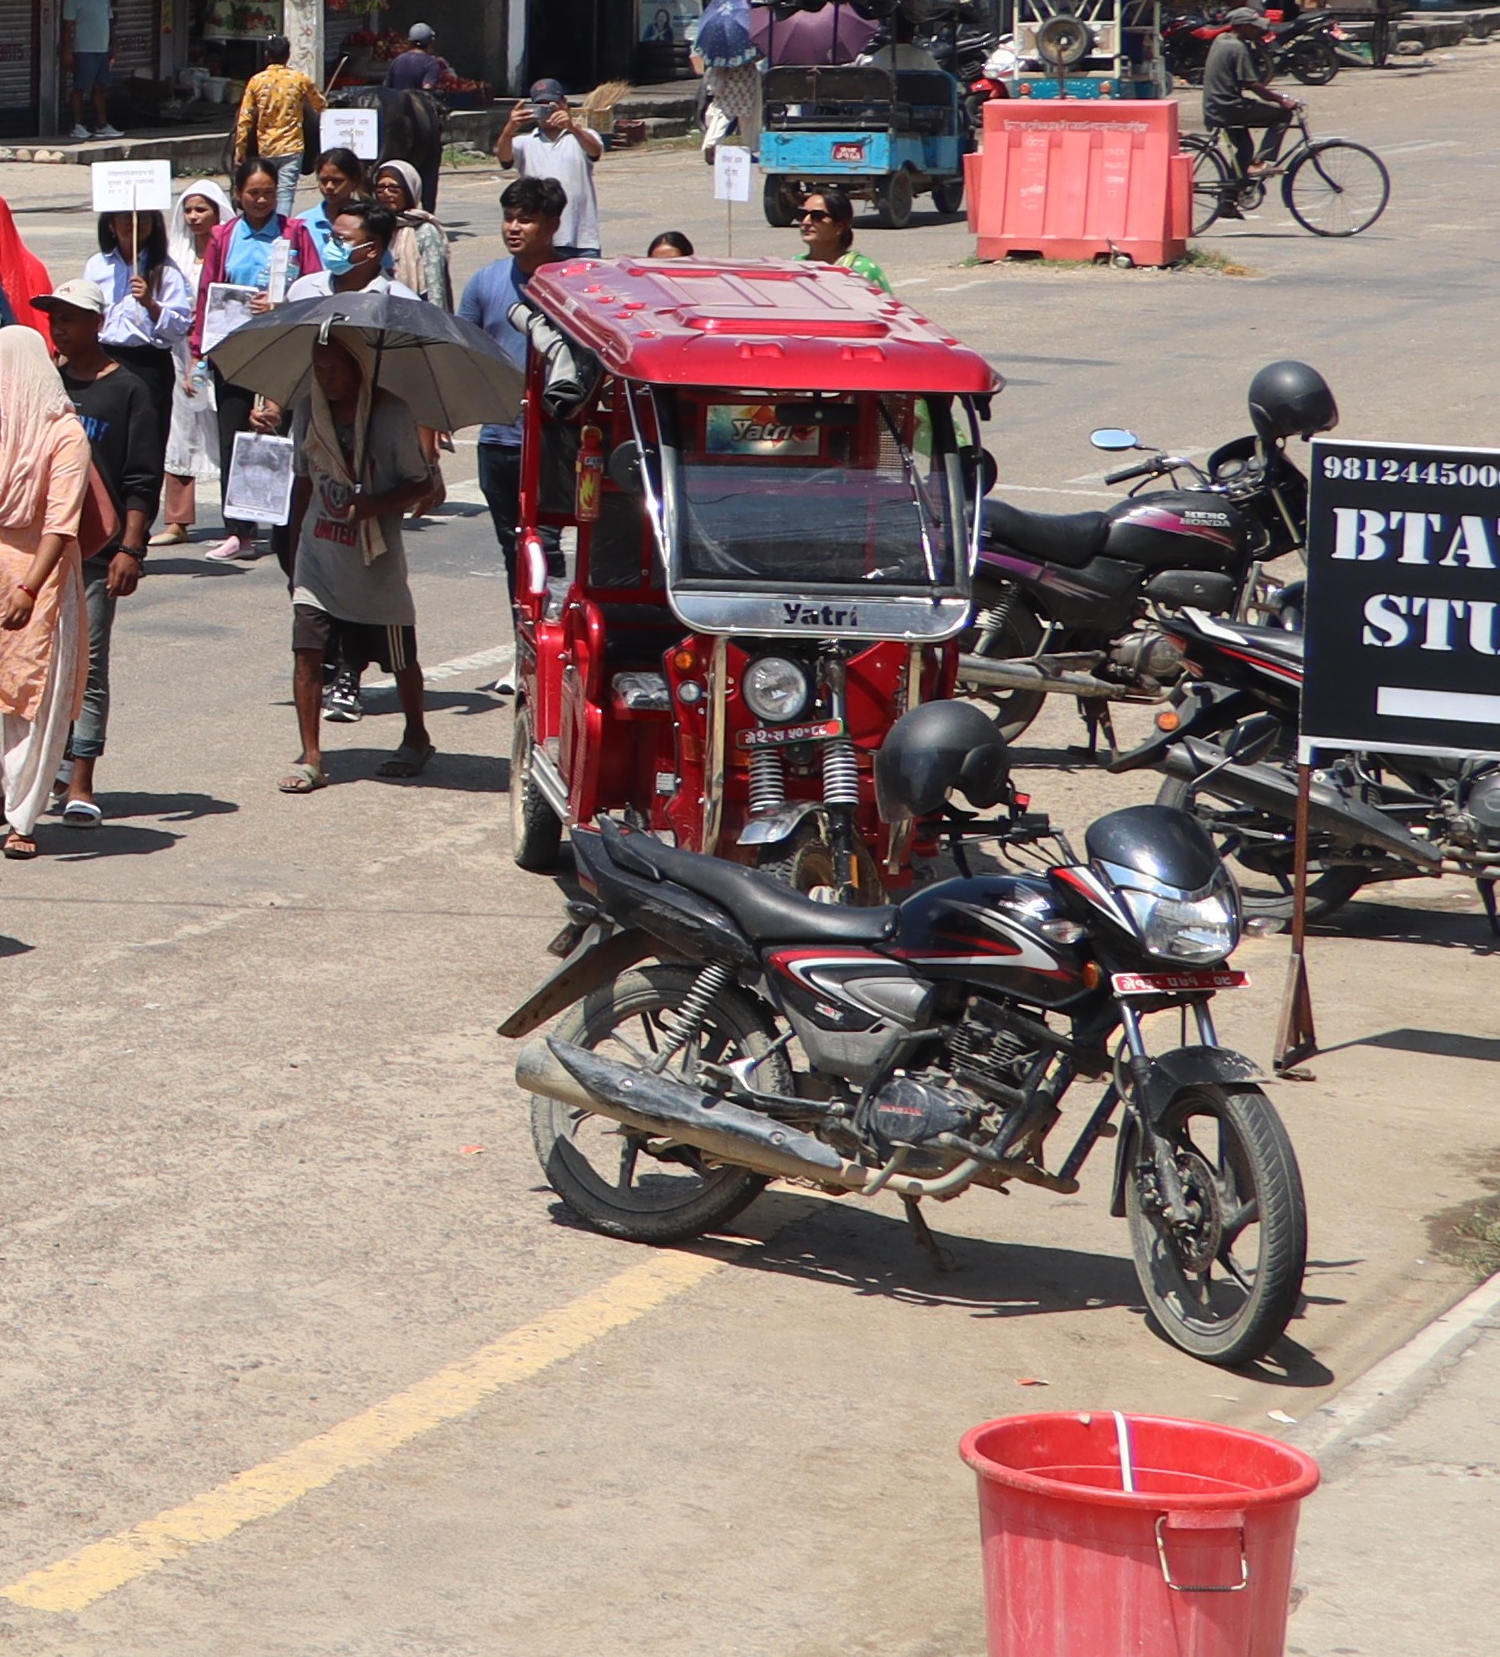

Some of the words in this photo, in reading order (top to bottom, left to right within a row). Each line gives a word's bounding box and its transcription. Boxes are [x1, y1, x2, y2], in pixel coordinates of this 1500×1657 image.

[1323, 455, 1500, 488] 981244500
[1179, 519, 1232, 528] HONDA
[1184, 510, 1228, 520] HERO
[1331, 507, 1500, 569] BTA
[782, 602, 859, 627] Yatri
